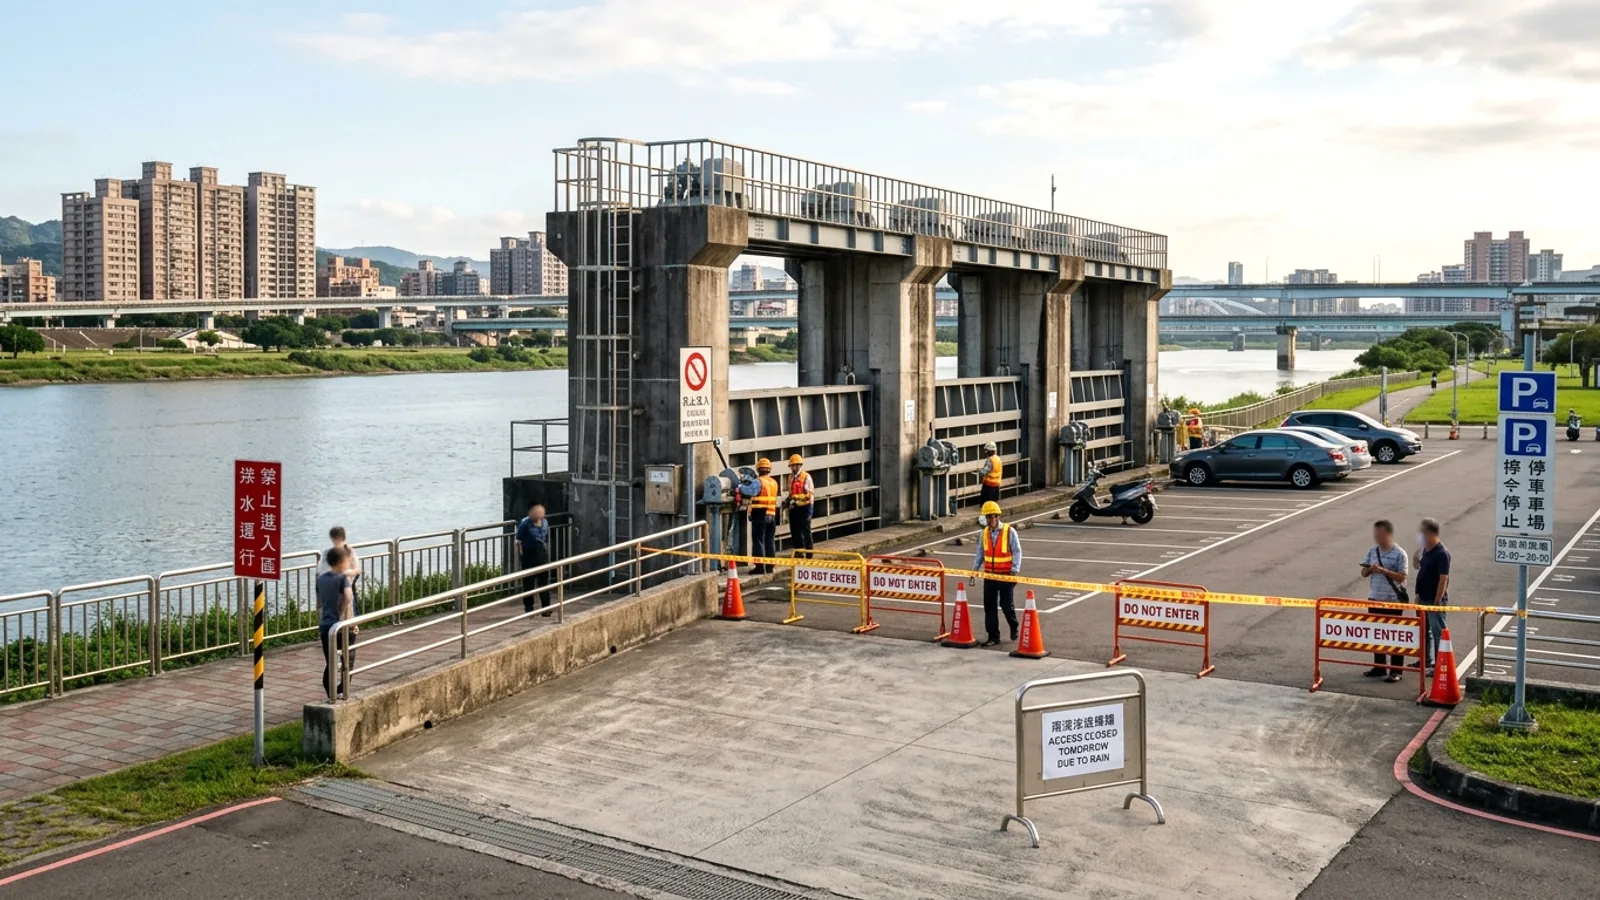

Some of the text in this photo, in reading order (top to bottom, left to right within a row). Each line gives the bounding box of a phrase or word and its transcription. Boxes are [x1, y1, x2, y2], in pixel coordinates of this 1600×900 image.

[1512, 377, 1538, 407] P
[1512, 422, 1537, 452] P
[798, 570, 809, 580] DO
[1124, 603, 1199, 621] DO NOT ENTER
[1325, 624, 1414, 643] DO NOT ENTER
[1057, 754, 1109, 768] DUE TO RAIN
